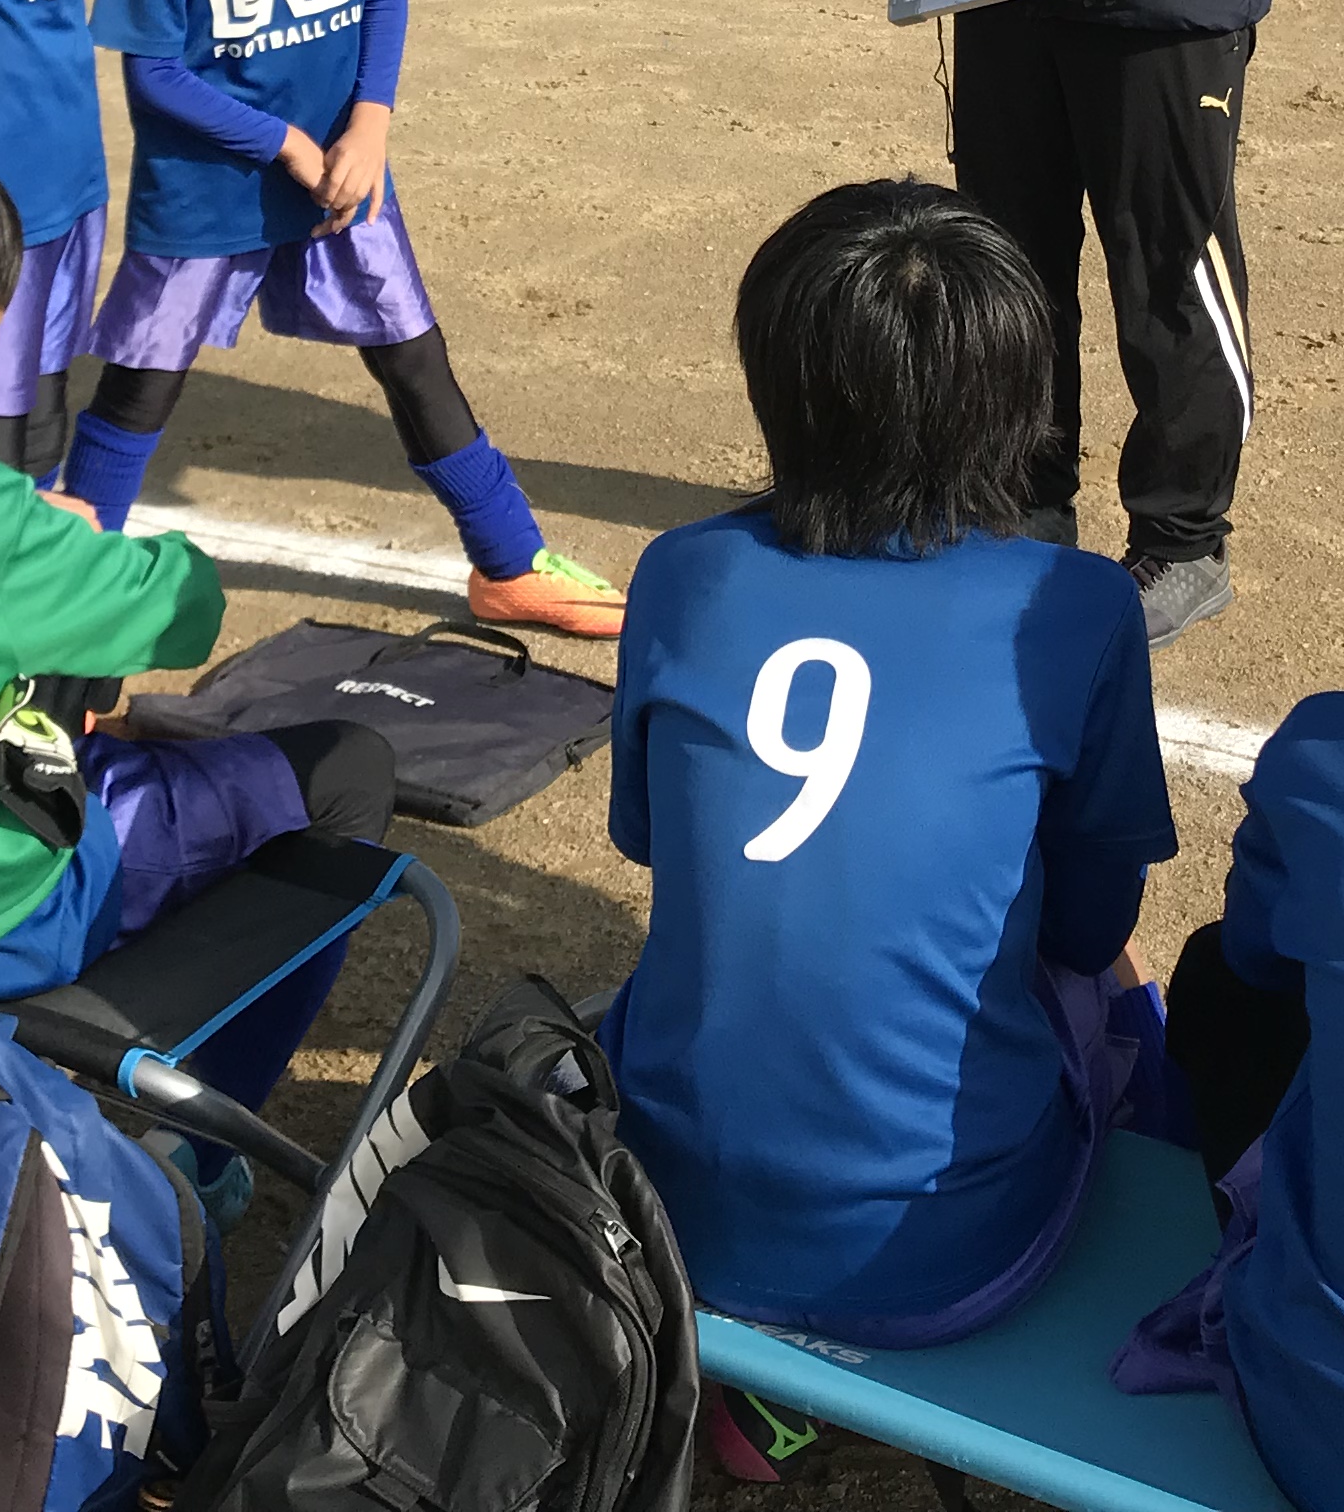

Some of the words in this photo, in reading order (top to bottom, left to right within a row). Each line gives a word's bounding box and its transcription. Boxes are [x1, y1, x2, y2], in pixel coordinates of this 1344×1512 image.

[213, 20, 326, 59] FOOTBALL
[329, 4, 362, 33] CLU
[335, 679, 436, 707] RESPECT
[744, 637, 872, 862] 9
[750, 1322, 872, 1365] EAKS
